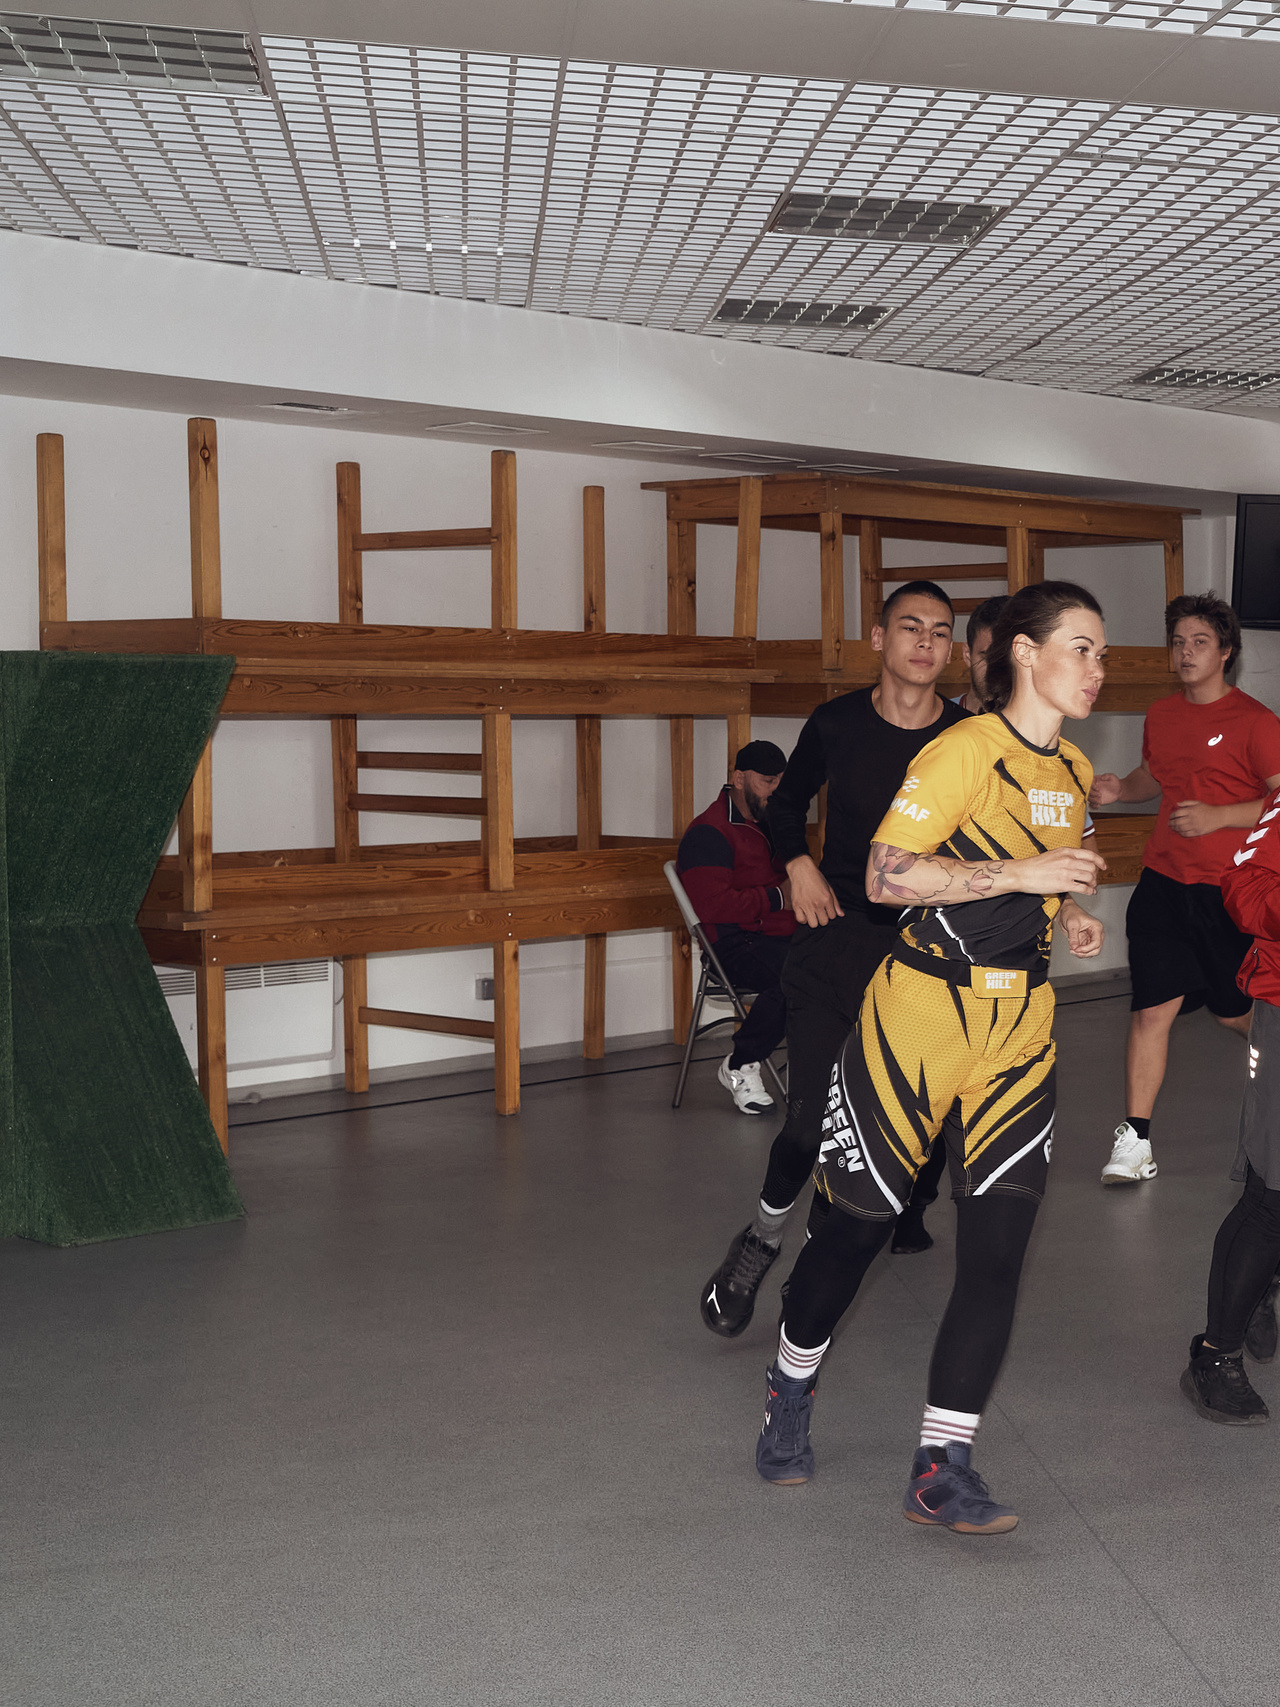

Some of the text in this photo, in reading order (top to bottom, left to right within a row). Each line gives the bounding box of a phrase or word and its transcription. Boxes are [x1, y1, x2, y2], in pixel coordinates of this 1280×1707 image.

[1028, 788, 1074, 807] GREEN
[890, 798, 930, 822] MAF
[1031, 804, 1071, 828] HILL
[985, 972, 1017, 980] GREEN
[986, 979, 1012, 990] HILL
